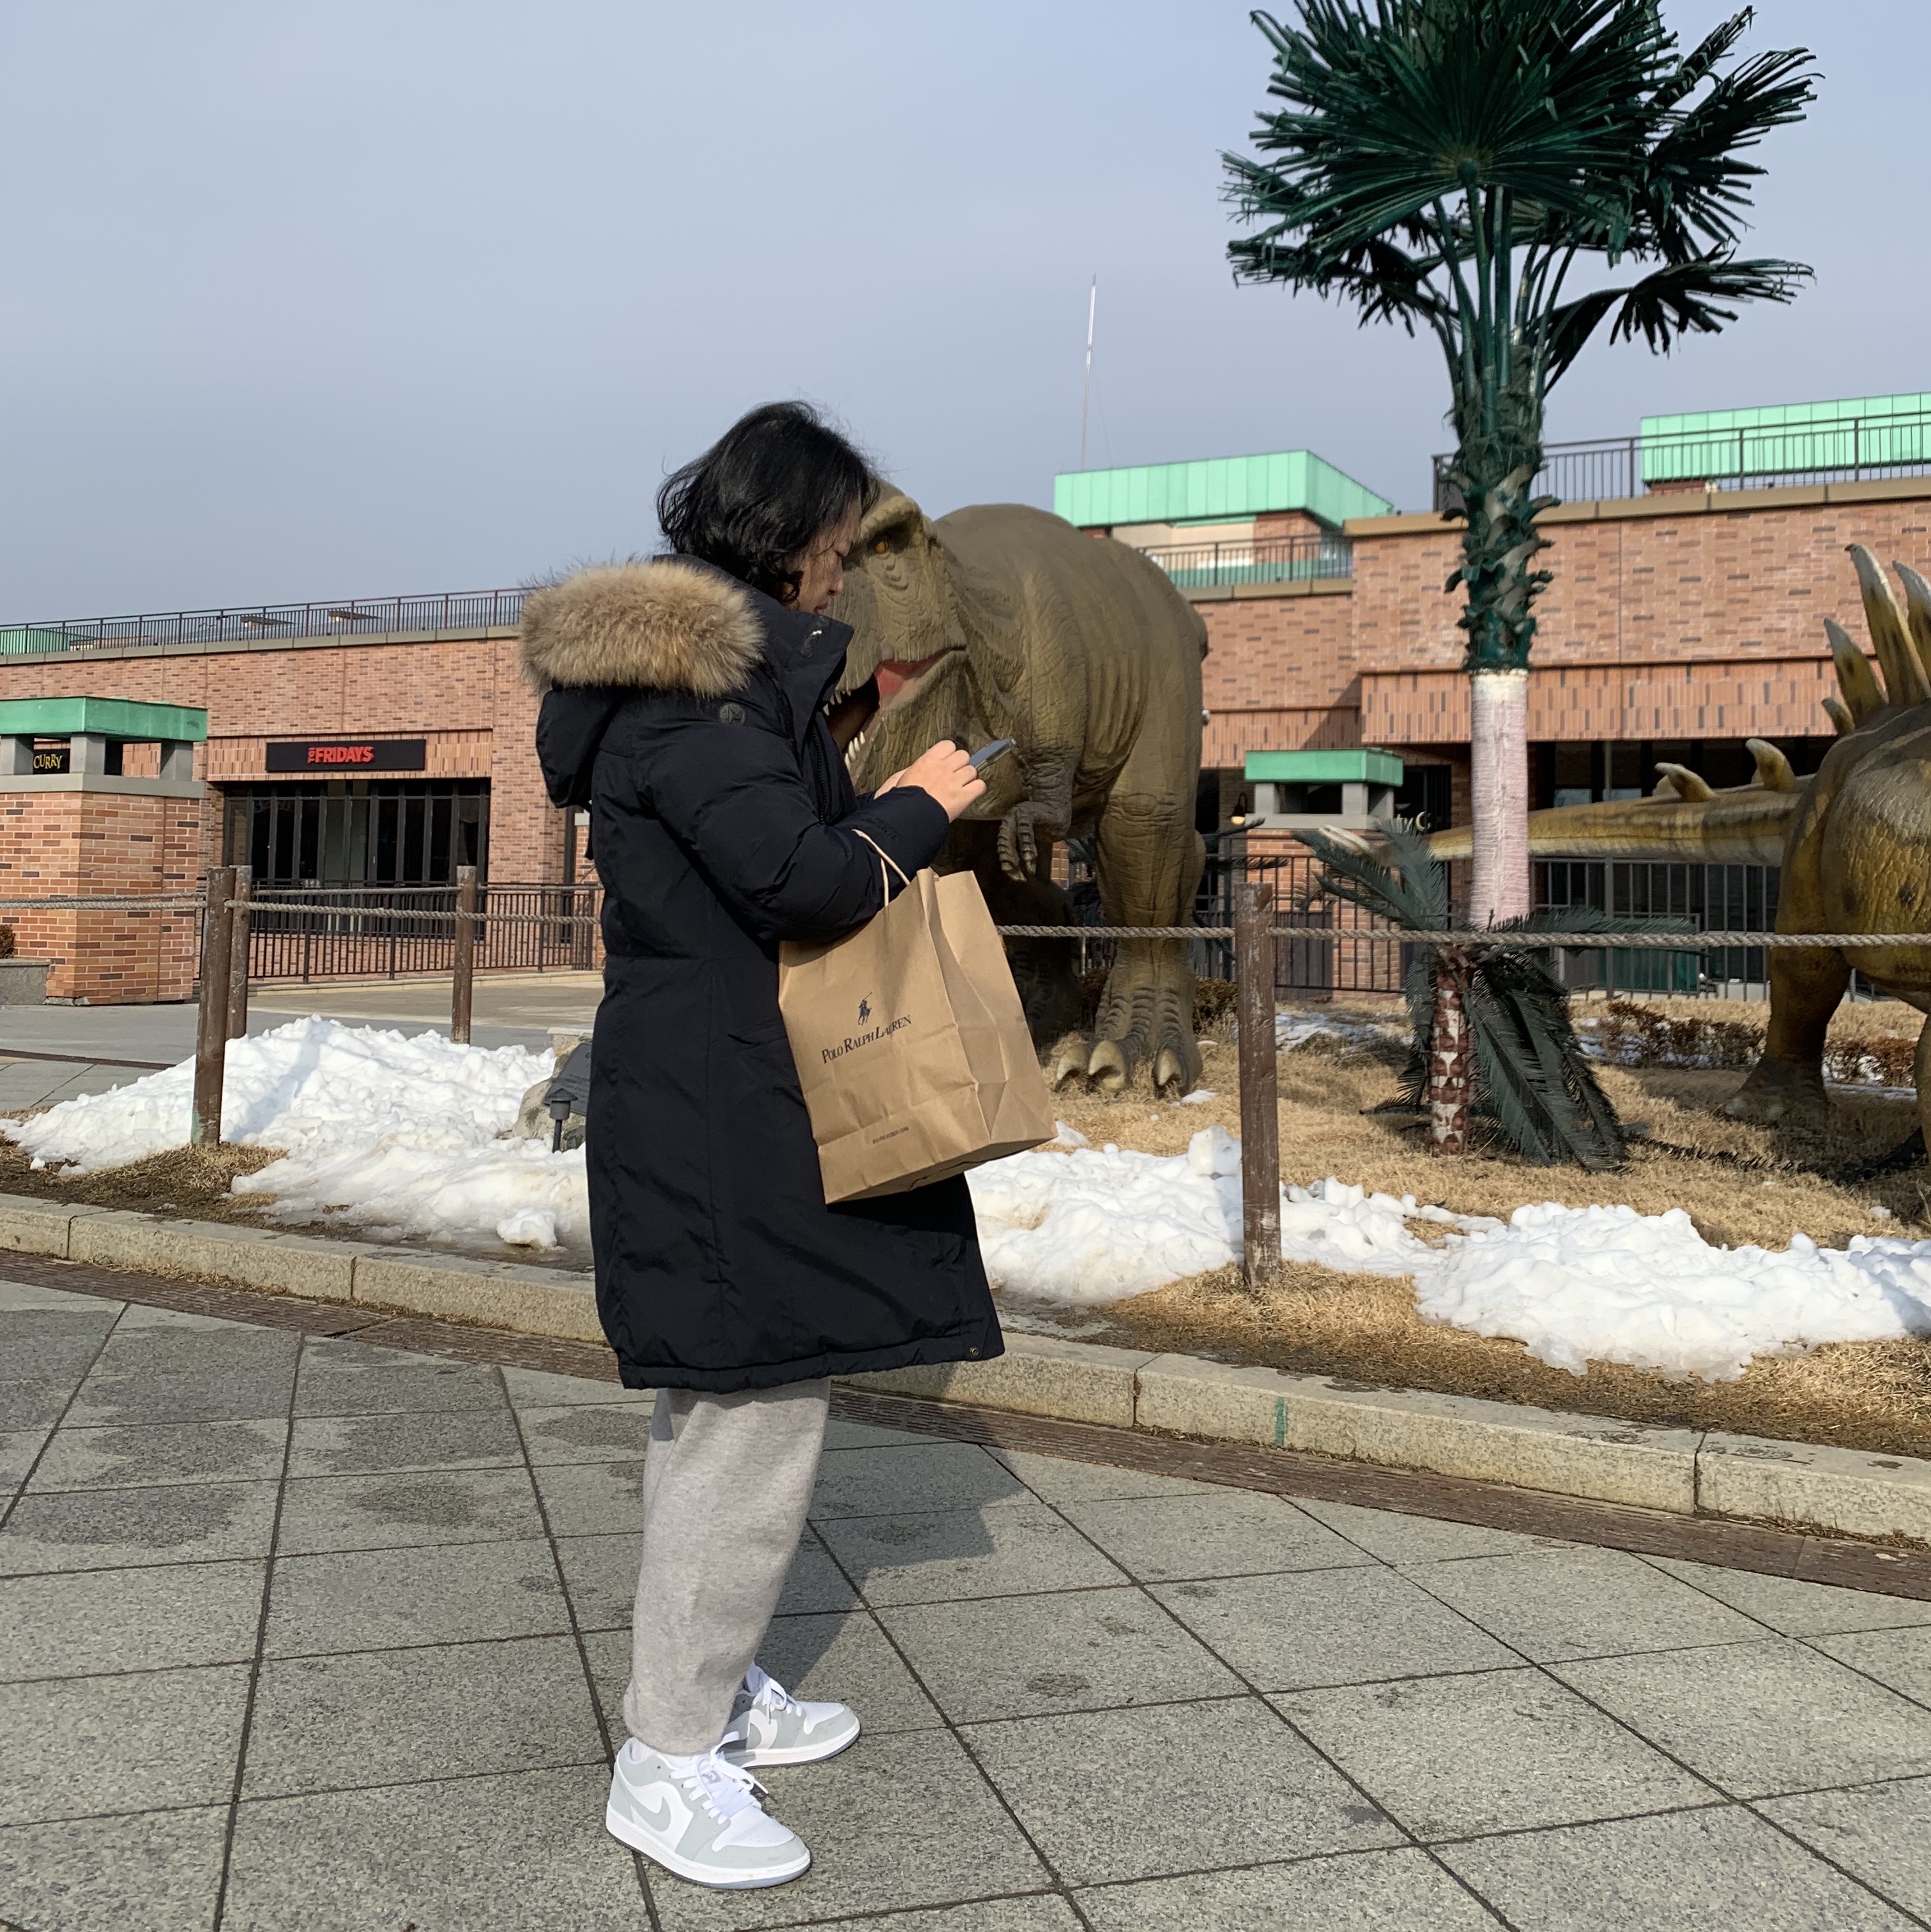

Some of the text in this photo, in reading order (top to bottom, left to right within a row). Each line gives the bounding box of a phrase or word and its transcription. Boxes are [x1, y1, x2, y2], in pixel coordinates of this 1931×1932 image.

[33, 754, 63, 769] CURRY
[315, 746, 374, 763] FRIDAYS
[821, 1014, 912, 1064] POLO RALPH LAUREN
